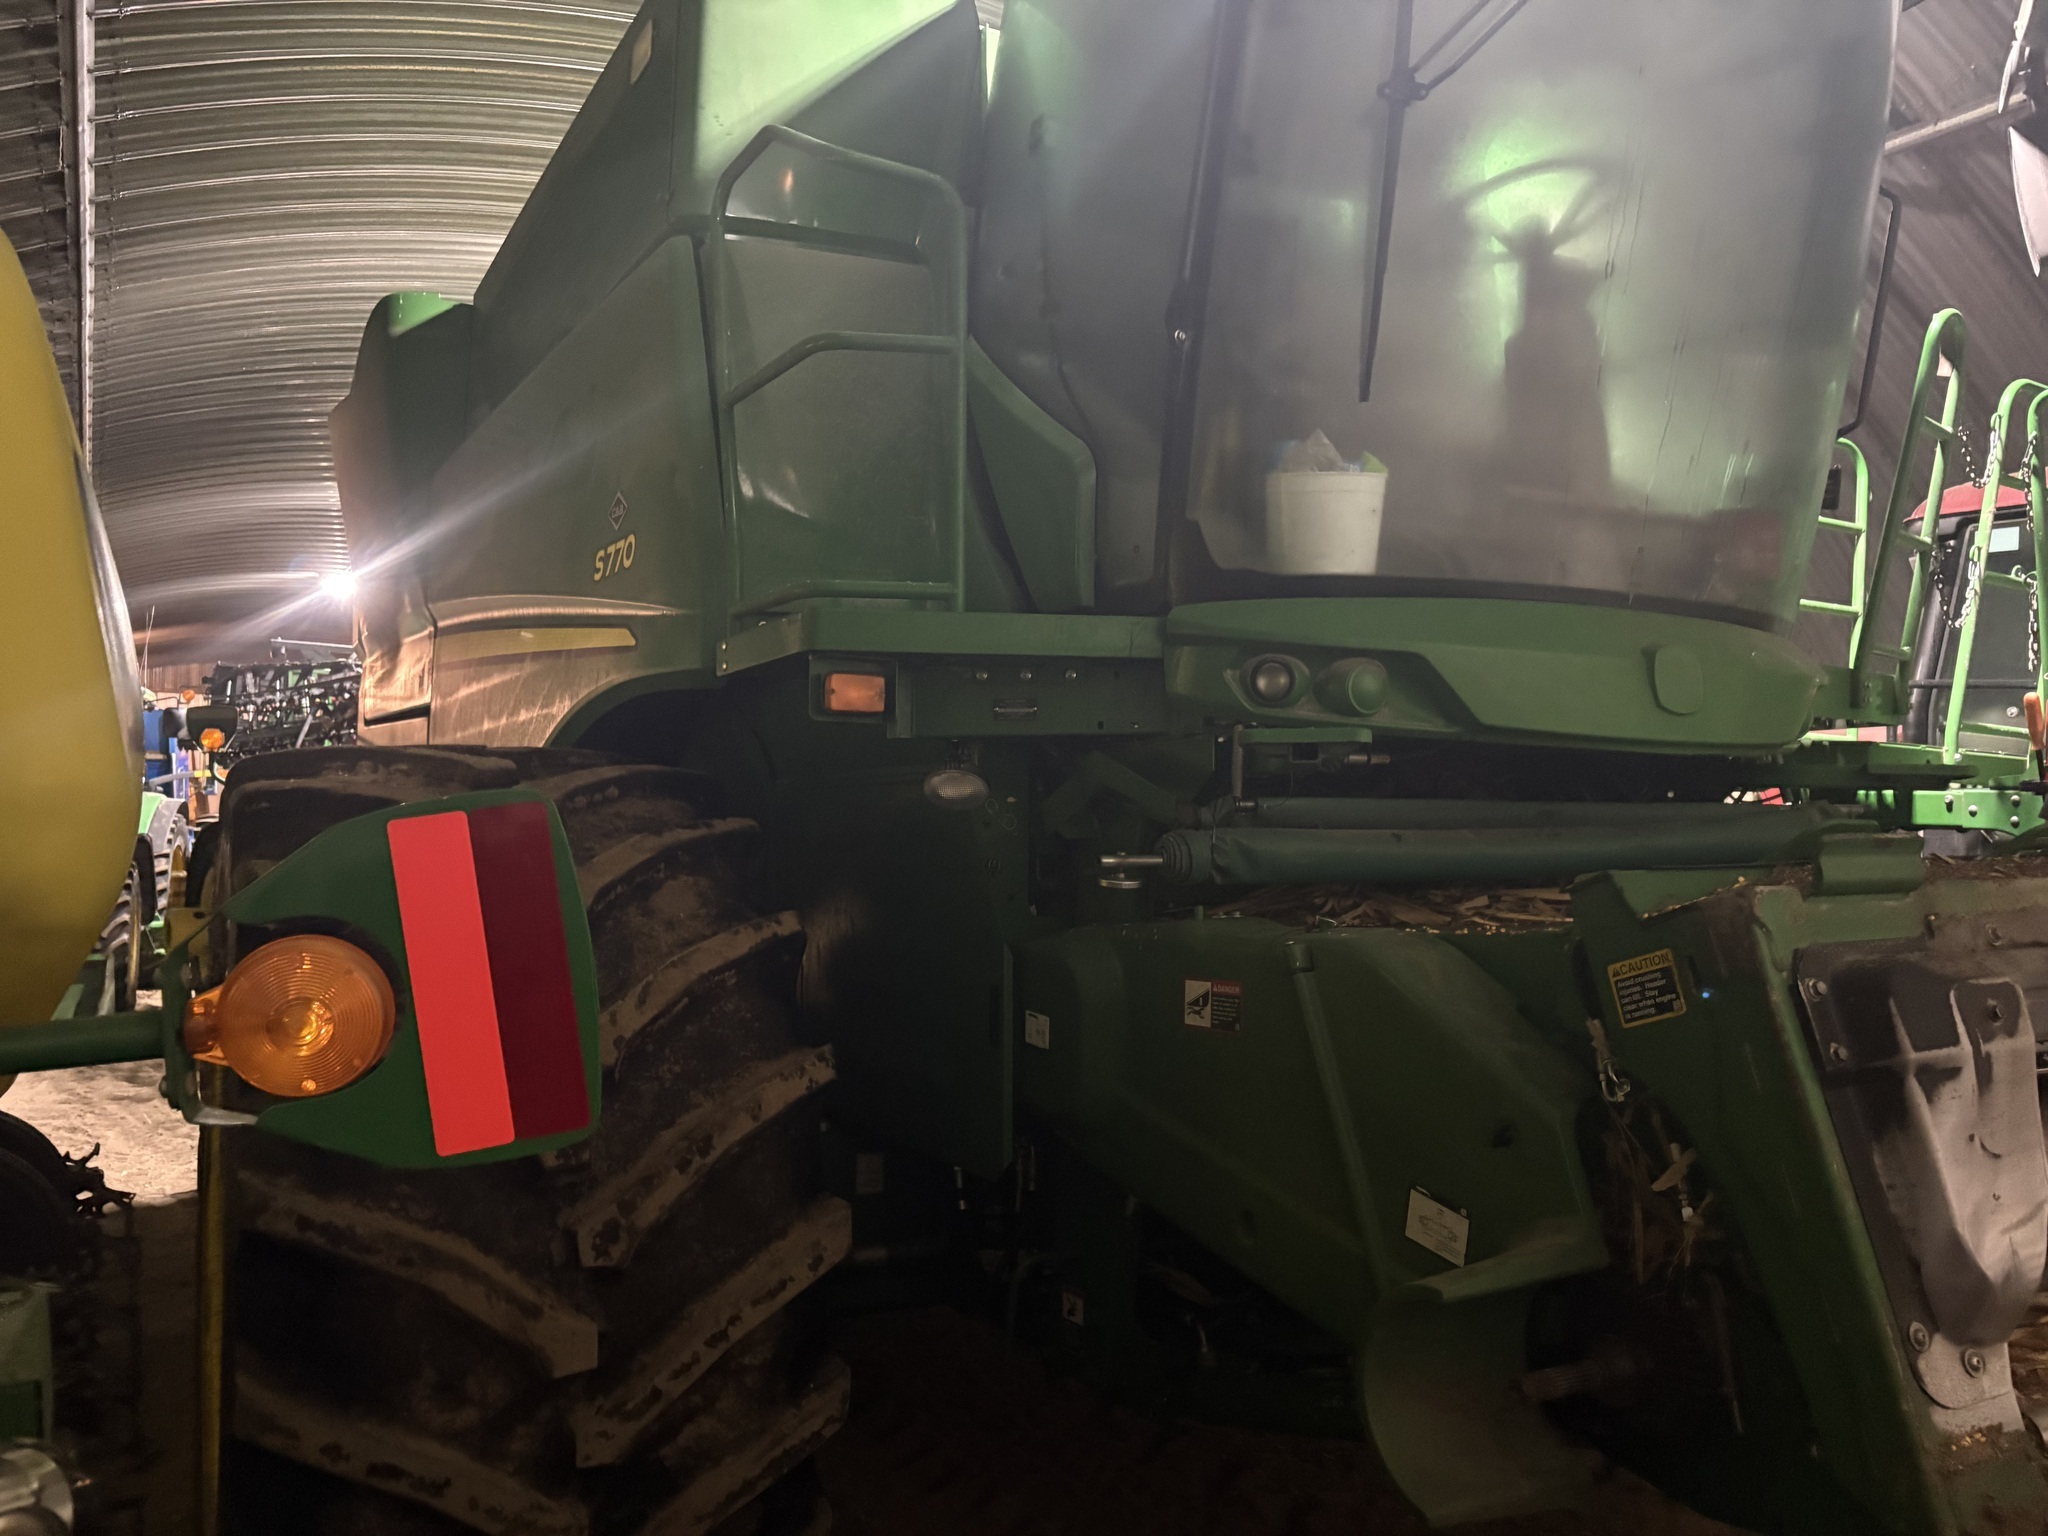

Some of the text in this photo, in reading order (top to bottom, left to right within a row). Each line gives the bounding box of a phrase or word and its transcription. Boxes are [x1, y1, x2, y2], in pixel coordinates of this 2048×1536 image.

[593, 534, 636, 581] S770
[1619, 952, 1669, 975] CAUTION
[1217, 984, 1240, 994] DANGER
